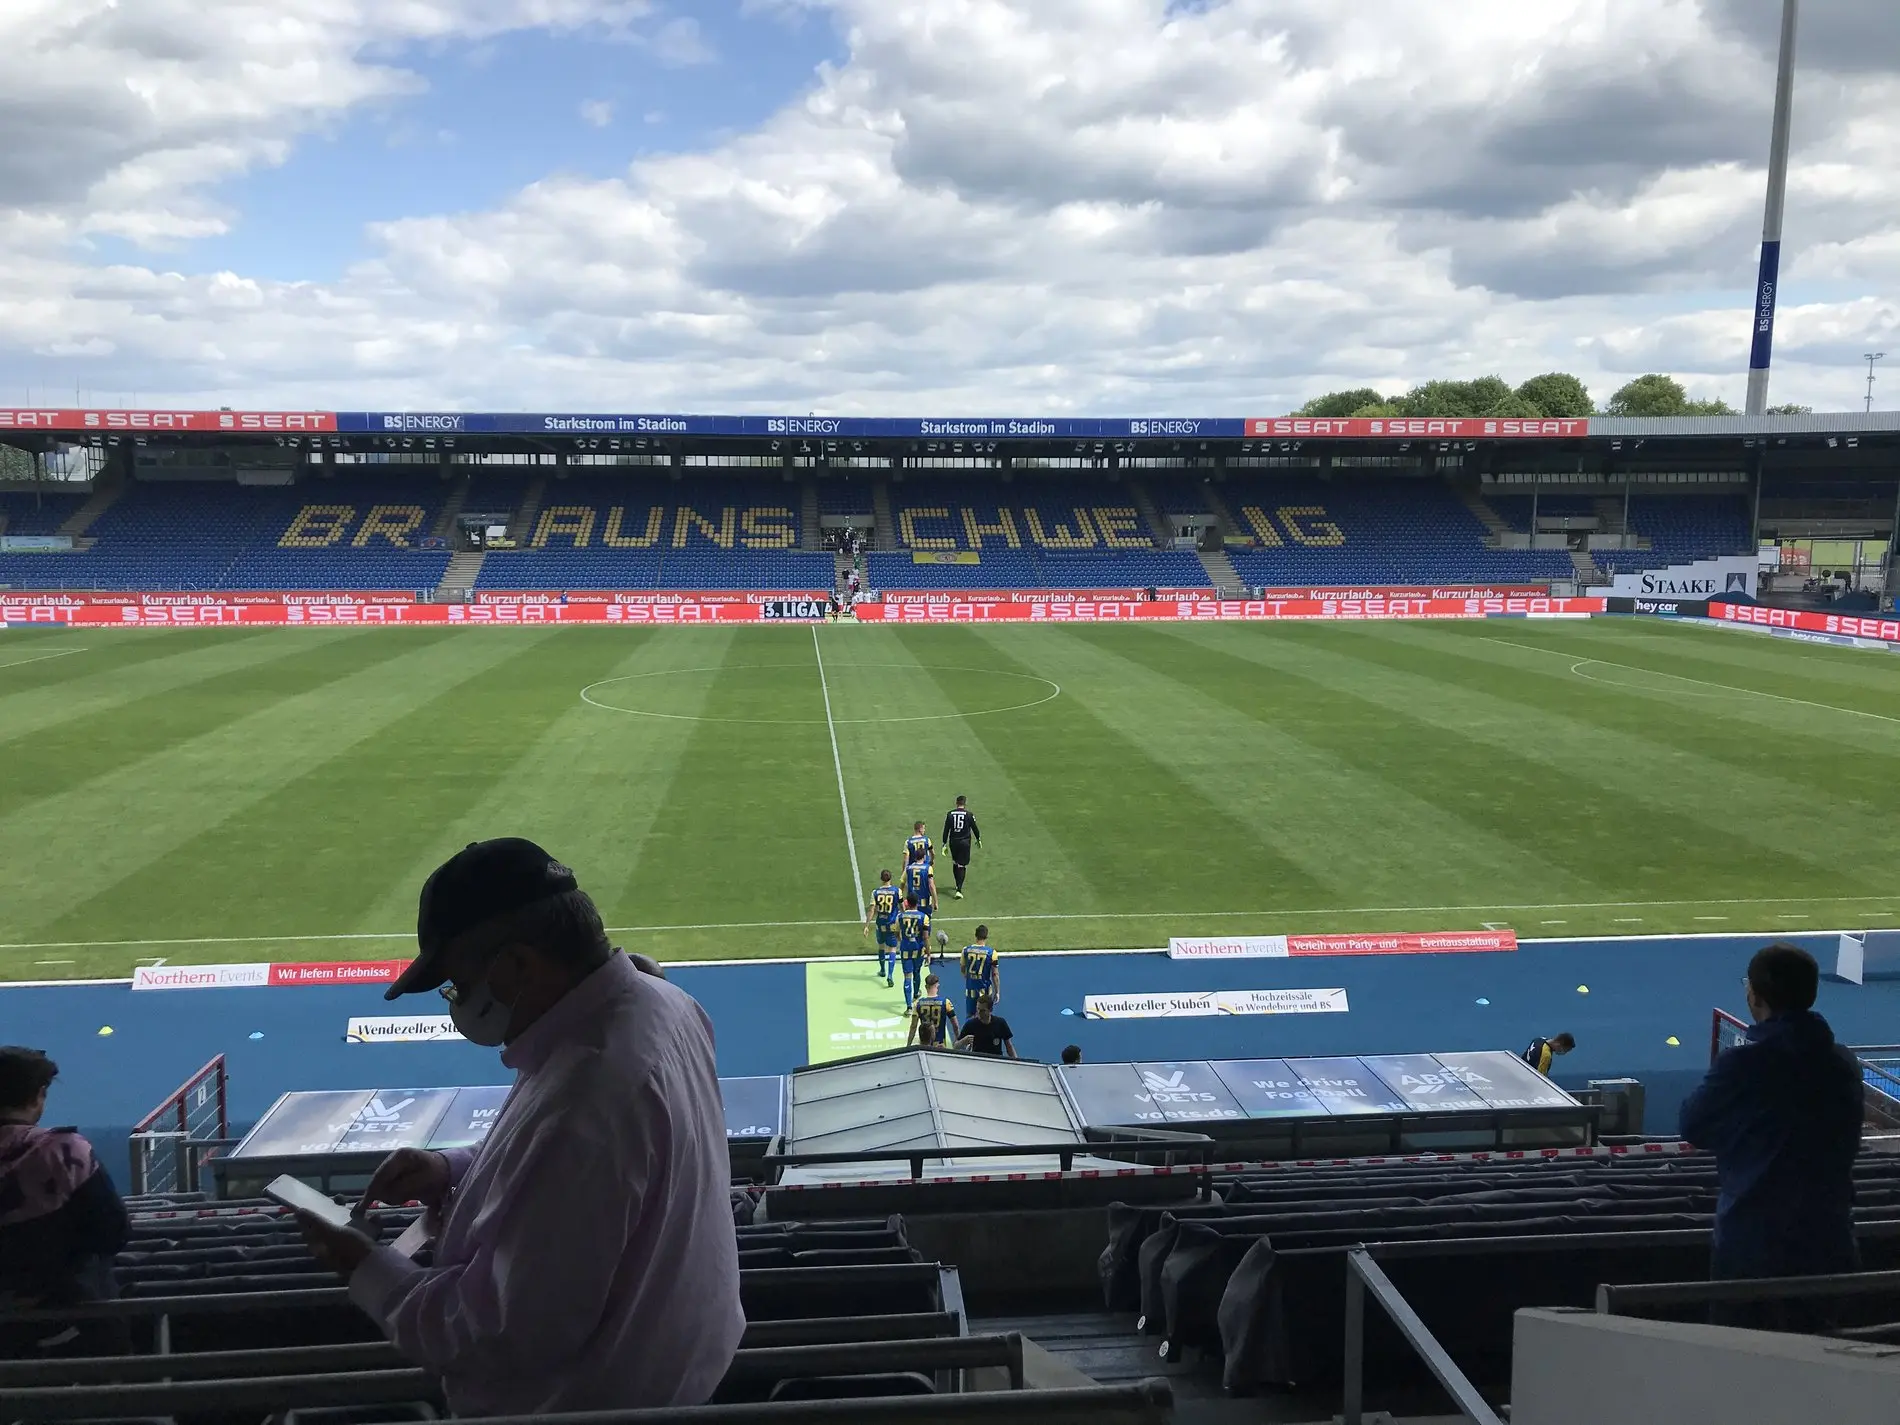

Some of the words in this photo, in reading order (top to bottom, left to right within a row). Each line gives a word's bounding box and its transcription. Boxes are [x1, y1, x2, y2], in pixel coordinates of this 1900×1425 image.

[106, 413, 194, 427] SEAT
[241, 415, 326, 428] SEAT
[544, 417, 615, 430] Starkstrom
[618, 418, 634, 430] im
[638, 418, 687, 431] Stadion
[920, 421, 988, 434] Starkstrom
[991, 422, 1006, 434] im
[1008, 421, 1055, 434] Stadion
[1274, 421, 1349, 433] SEAT
[1389, 421, 1463, 434] SEAT
[1502, 422, 1578, 434] SEAT
[1640, 574, 1716, 594] STAAKE
[142, 594, 226, 606] Kurzurlaub.de
[282, 594, 366, 604] Kurzurlaub.de
[614, 594, 694, 604] Kurzurlaub.de
[886, 593, 962, 603] Kurzurlaub.de
[1012, 592, 1086, 602] Kurzurlaub.de
[1136, 592, 1210, 602] Kuzurlaub.de
[1310, 590, 1384, 600] Kurzurlaub.de
[1432, 588, 1504, 599] Kurzurlaub.de
[470, 604, 568, 619] SEAT
[628, 604, 724, 618] SEAT
[765, 603, 779, 617] 3.
[782, 602, 820, 617] LIGA
[904, 604, 996, 618] SEAT
[1050, 602, 1142, 616] SEAT
[1196, 602, 1288, 616] SEAT
[1342, 600, 1432, 614] SEAT
[1484, 598, 1572, 612] SEAT
[1636, 600, 1656, 612] hey
[1658, 603, 1678, 611] car
[144, 606, 248, 621] SEAT
[308, 606, 410, 620] SEAT
[1736, 607, 1801, 627] SEAT
[953, 814, 964, 829] 16
[912, 868, 920, 887] 5
[877, 895, 894, 912] 38
[1176, 942, 1242, 954] Northern
[1245, 941, 1284, 954] Events
[1294, 940, 1327, 950] Verleih
[1329, 942, 1346, 950] von
[1349, 938, 1376, 950] Party-
[1379, 938, 1398, 948] und
[1420, 937, 1500, 948] Eventausstattung
[968, 954, 987, 976] 27
[140, 970, 216, 986] Northern
[220, 969, 264, 983] Events
[278, 968, 297, 980] Wir
[300, 968, 334, 978] liefern
[336, 967, 390, 978] Erlebnisse
[1252, 992, 1312, 1002] Hochzeitssäle
[1094, 1000, 1166, 1012] Wendezeller
[1170, 998, 1210, 1010] Stuben
[1235, 1003, 1244, 1012] in
[1246, 1002, 1298, 1012] Wendeburg
[1300, 1002, 1319, 1010] und
[1320, 1000, 1332, 1010] BS
[358, 1022, 437, 1035] Wendezeller
[1252, 1080, 1290, 1088] We
[1296, 1077, 1358, 1087] drive
[1402, 1072, 1492, 1086] ABRA
[1134, 1092, 1216, 1102] VOETS
[1134, 1108, 1238, 1120] voets.de
[328, 1122, 414, 1133] VOETS
